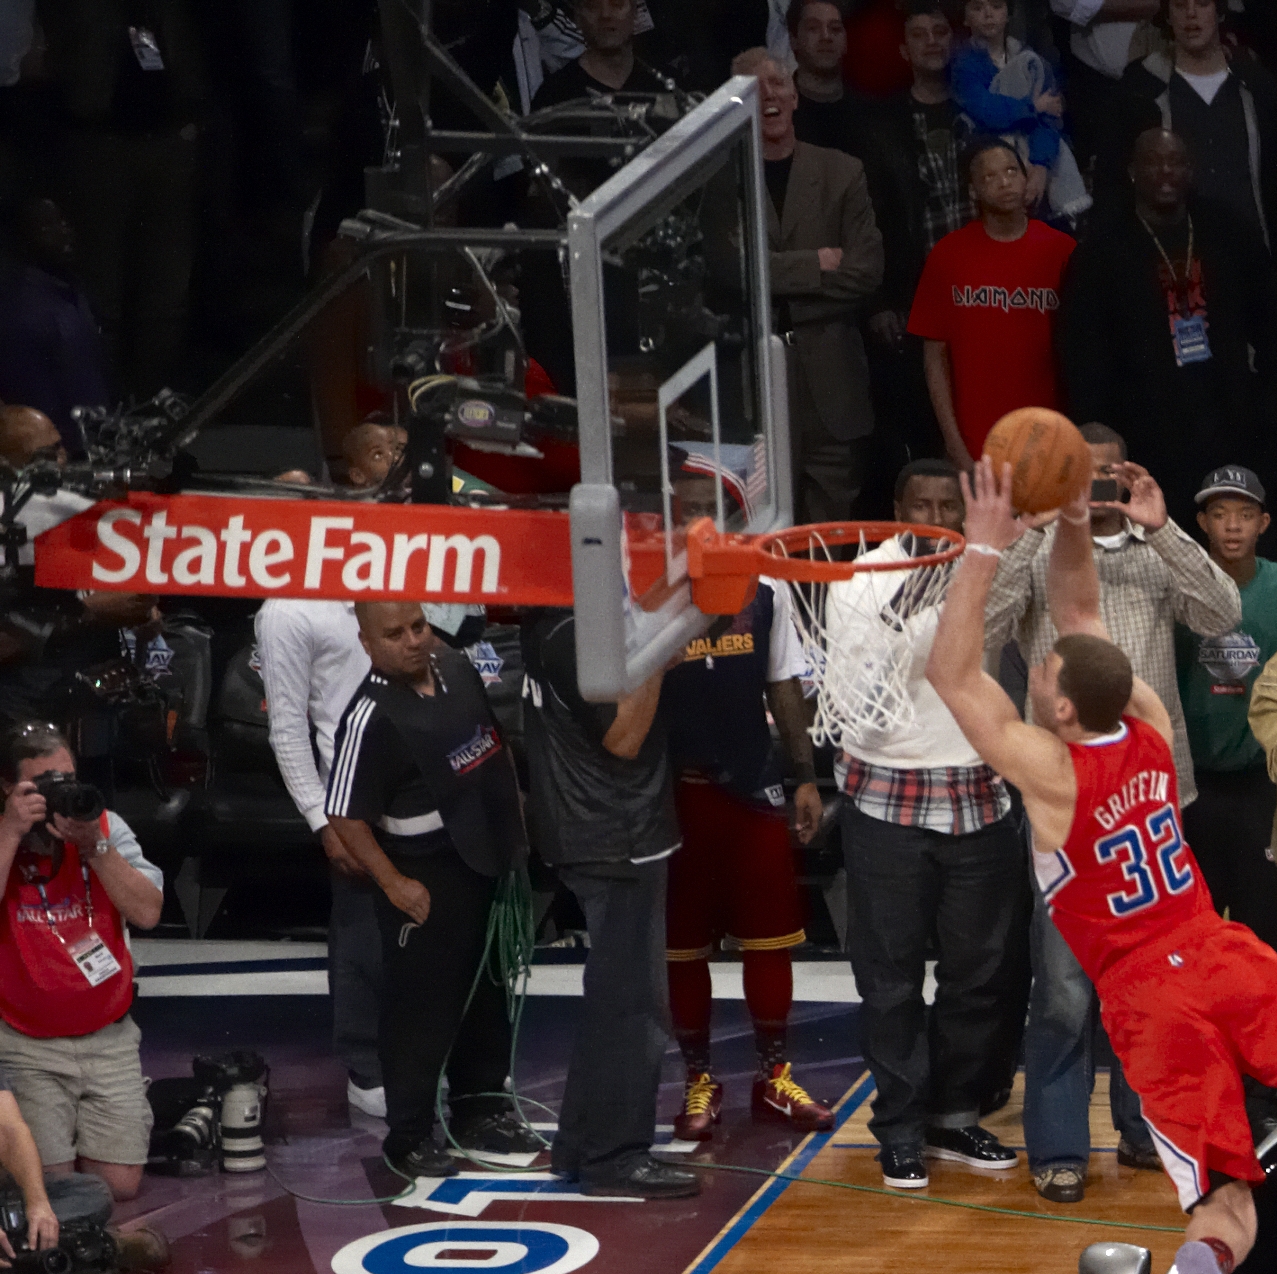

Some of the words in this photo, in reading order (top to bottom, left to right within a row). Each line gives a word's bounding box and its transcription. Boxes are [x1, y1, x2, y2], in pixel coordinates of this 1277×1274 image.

[952, 285, 1060, 314] DIAMOND
[91, 508, 295, 590] State
[303, 516, 502, 594] Farm
[685, 632, 755, 657] VALIERS
[1199, 648, 1259, 660] SATURDAY
[1093, 770, 1170, 831] GRIFFIN
[1094, 802, 1195, 918] 32
